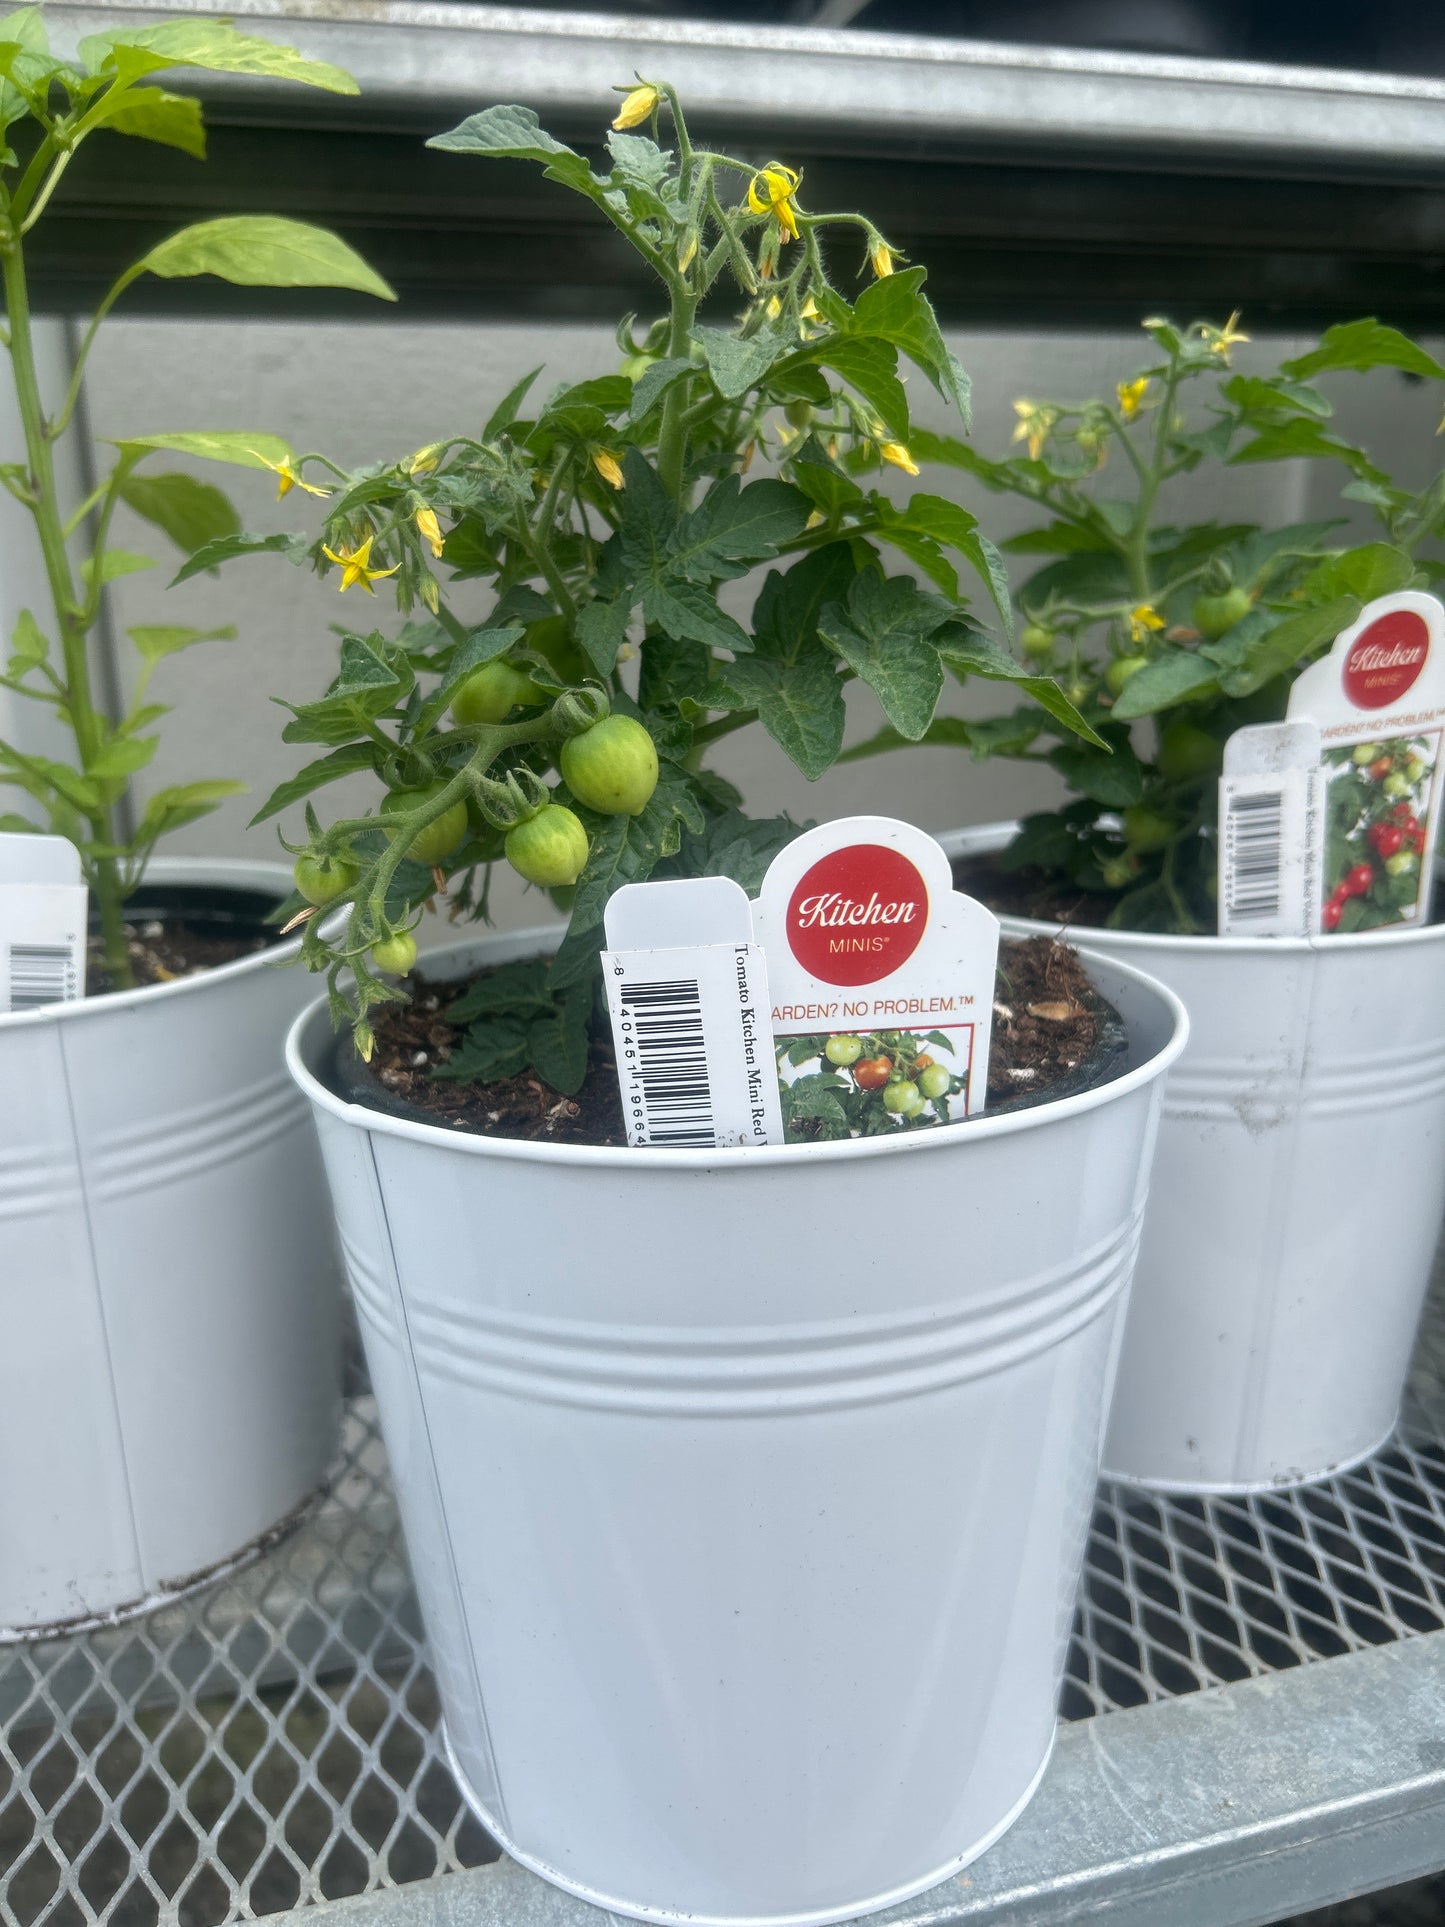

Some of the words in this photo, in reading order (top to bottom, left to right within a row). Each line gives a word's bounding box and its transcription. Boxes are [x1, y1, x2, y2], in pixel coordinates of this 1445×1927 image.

[1349, 640, 1423, 674] Kitchen
[798, 892, 921, 929] Kitchen
[614, 966, 625, 976] 8
[734, 943, 750, 1004] Tomato
[843, 1002, 868, 1017] NO
[741, 1007, 758, 1066] Kitchen
[747, 1069, 764, 1104] Mini
[751, 1107, 767, 1137] Red
